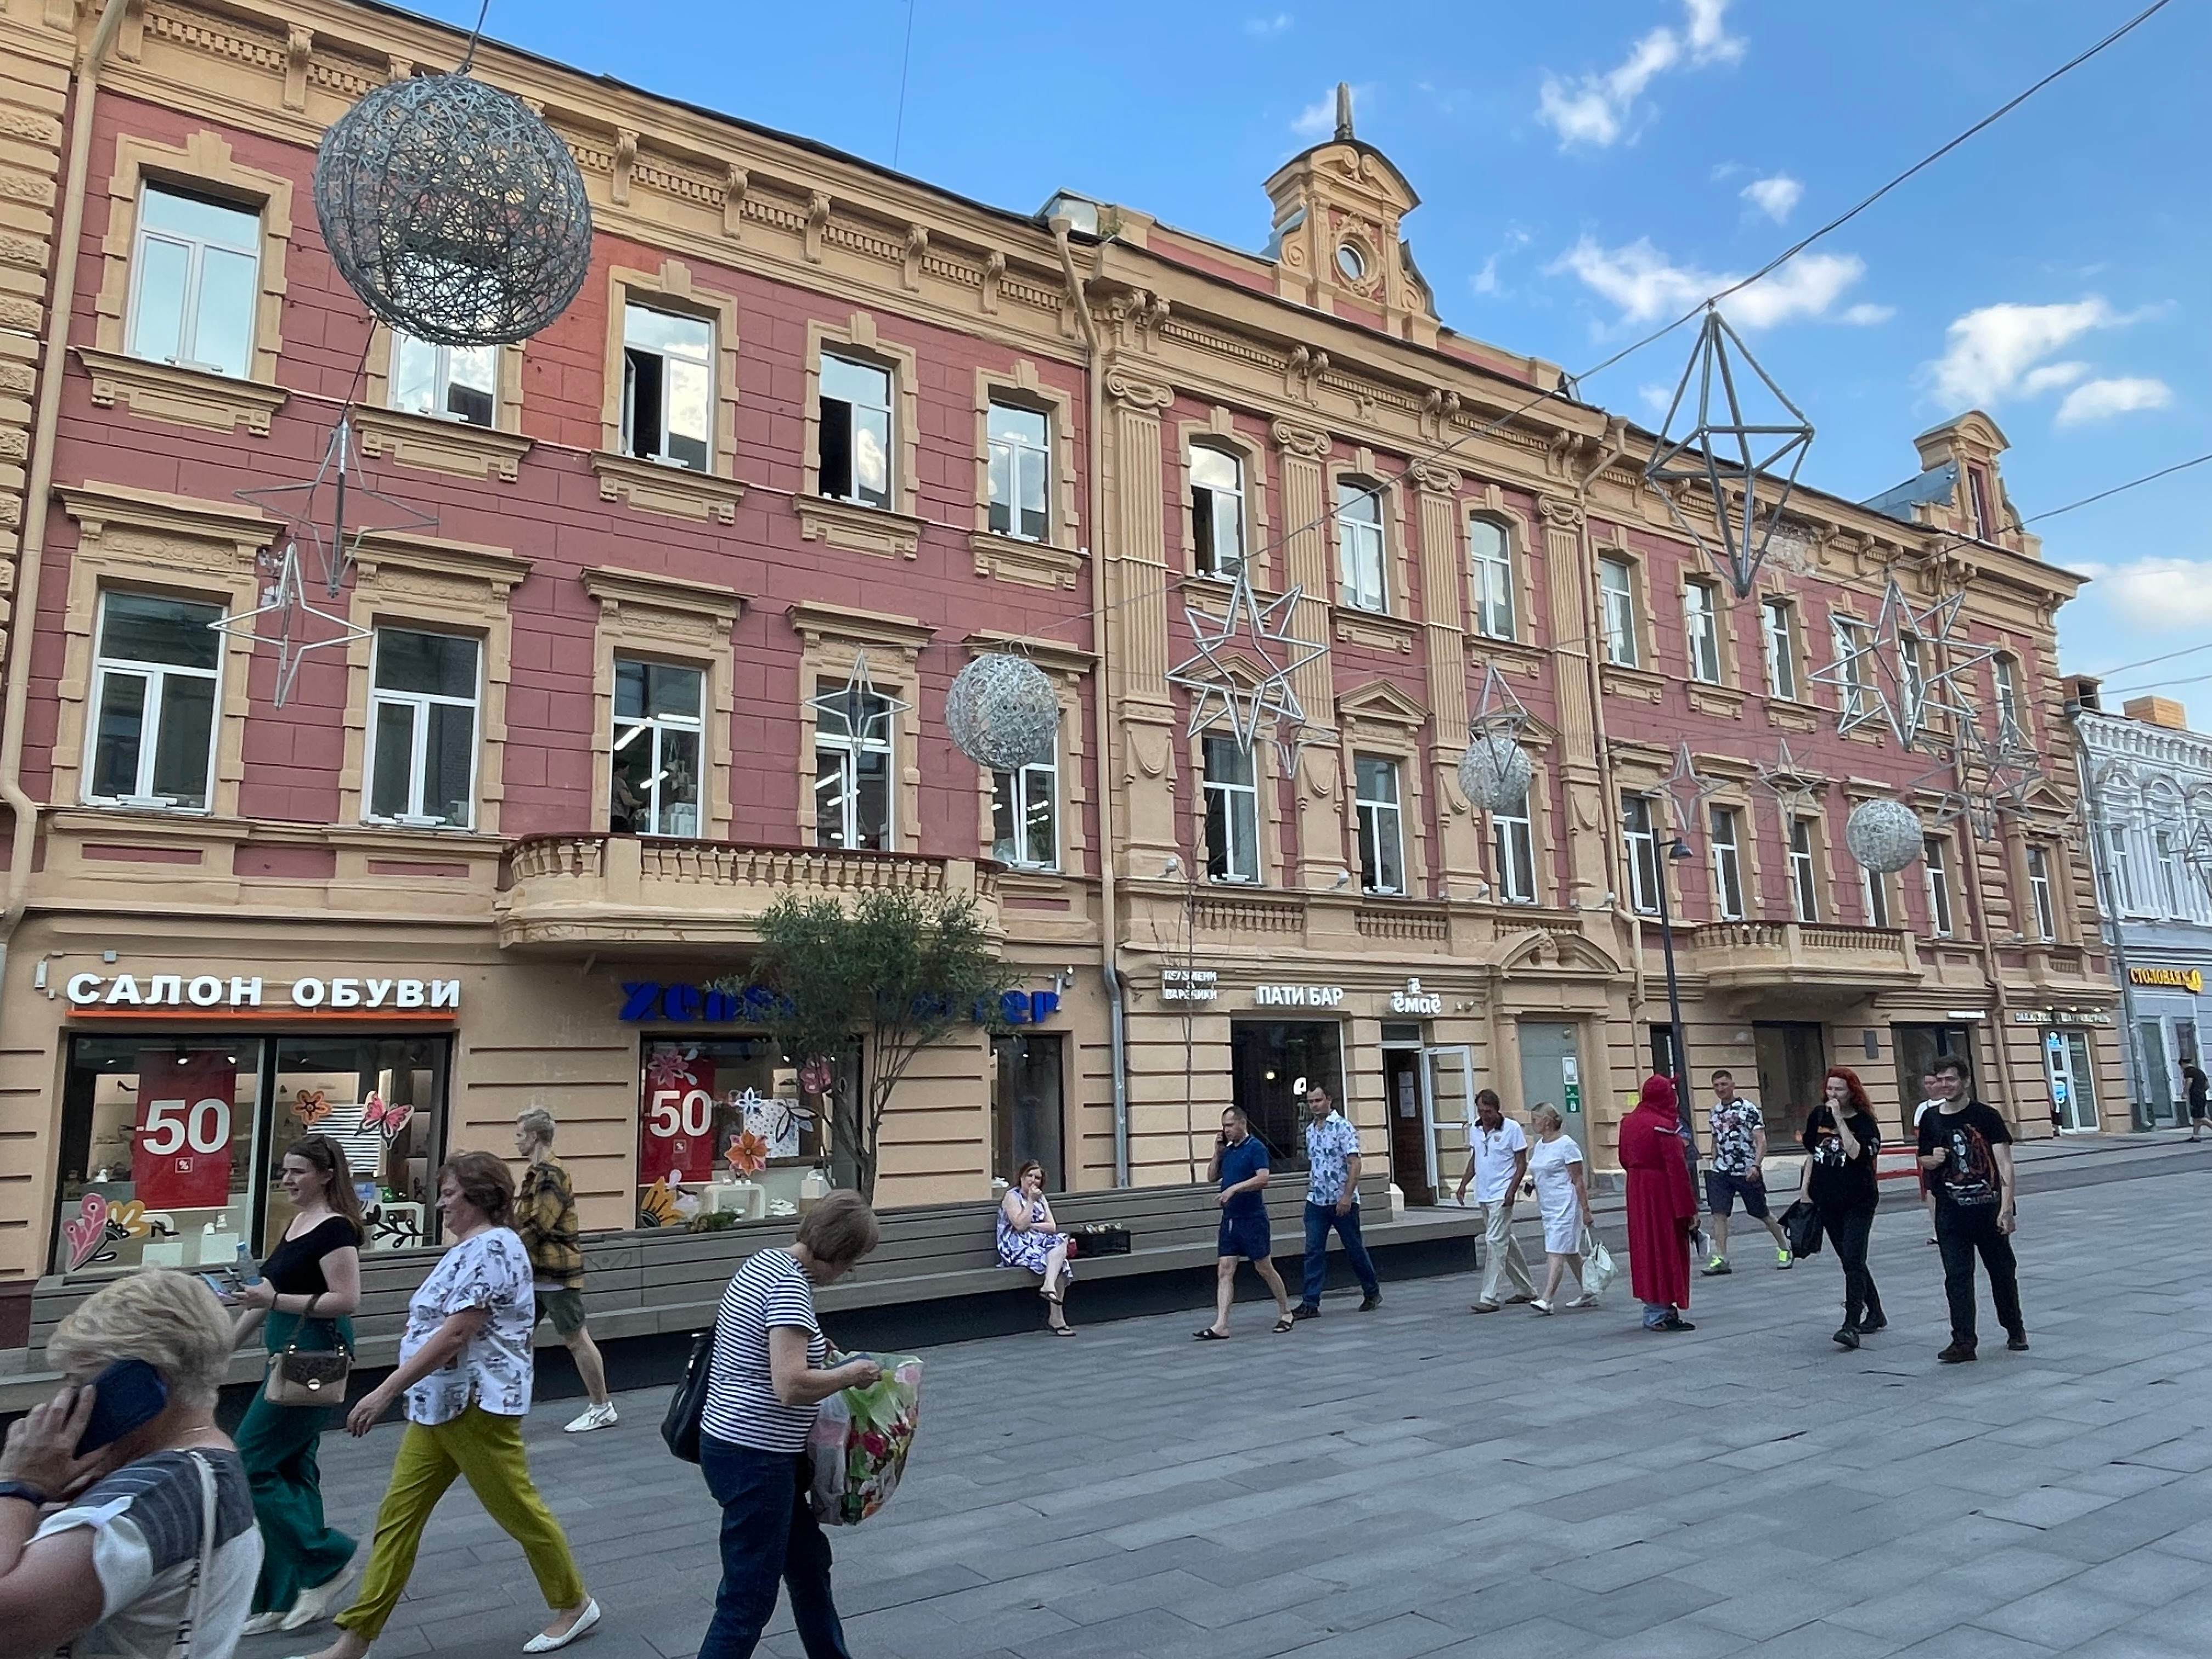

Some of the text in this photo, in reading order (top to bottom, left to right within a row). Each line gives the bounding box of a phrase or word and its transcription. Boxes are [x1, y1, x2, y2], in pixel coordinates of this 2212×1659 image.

[66, 973, 460, 1007] САЛОН ОБУВИ
[1256, 985, 1344, 1006] ПАТИ БАР
